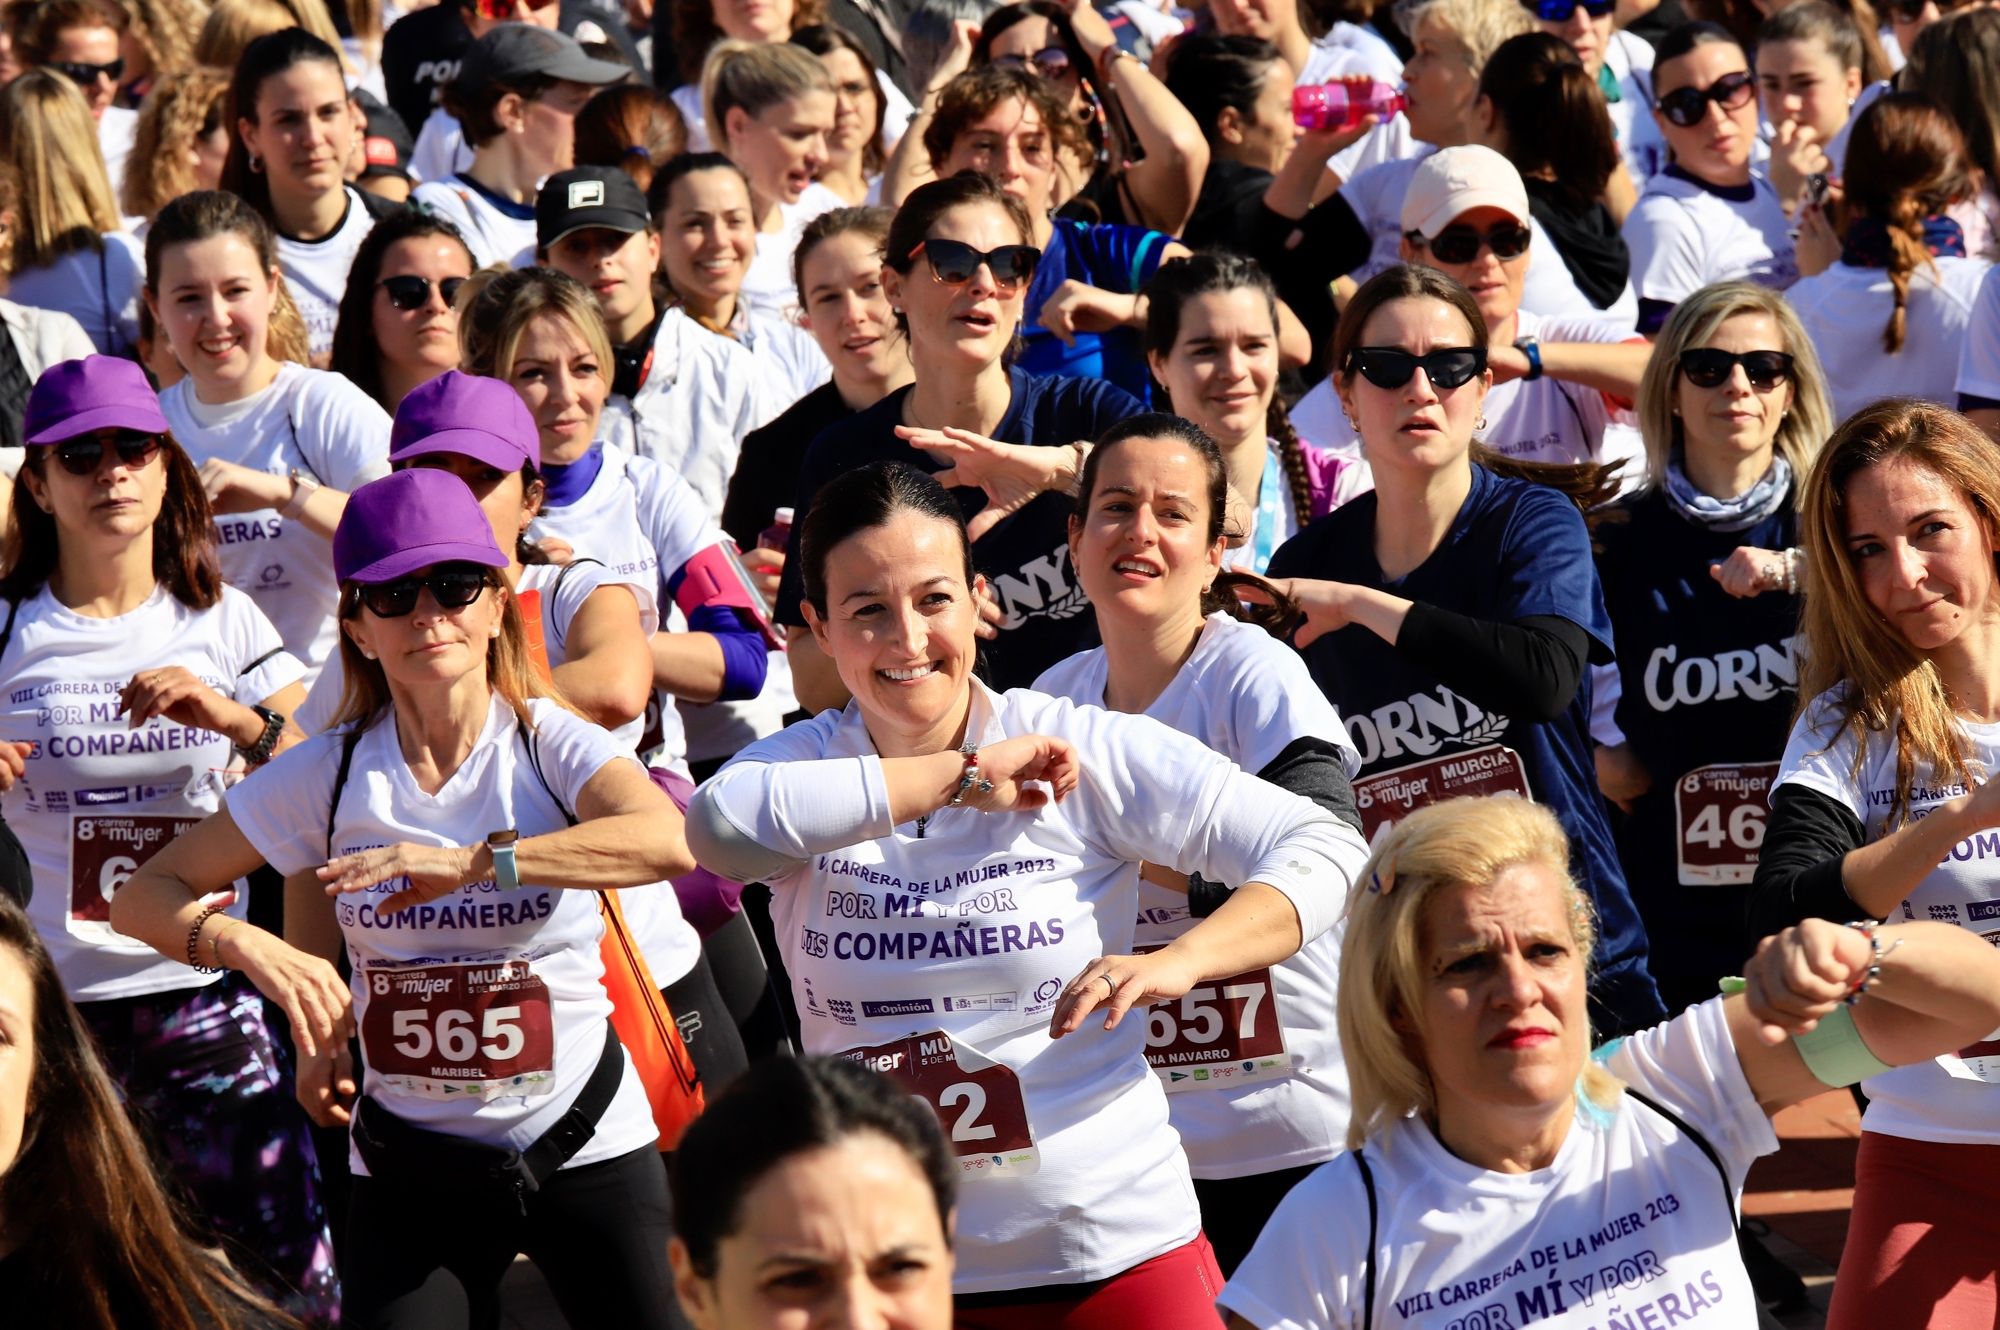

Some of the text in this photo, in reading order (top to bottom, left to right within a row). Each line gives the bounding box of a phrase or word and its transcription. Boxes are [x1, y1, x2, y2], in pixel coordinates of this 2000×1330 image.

[10, 689, 35, 704] VIII
[38, 682, 99, 698] CARRERA
[104, 682, 120, 694] DE
[37, 705, 84, 727] POR
[48, 723, 221, 758] COMPAÑERAS
[1440, 752, 1510, 780] MURCIA
[1463, 770, 1493, 784] MARZO
[1381, 778, 1428, 808] mujer
[1715, 777, 1768, 799] mujer
[98, 819, 134, 828] carrera
[109, 827, 163, 851] mujer
[831, 859, 902, 888] CARRERA
[907, 882, 930, 894] DE
[935, 876, 952, 893] LA
[956, 863, 1010, 888] MUJER
[1015, 858, 1056, 874] 2023
[358, 892, 551, 930] COMPAÑERAS
[826, 891, 877, 919] POR
[960, 888, 1018, 916] POR
[834, 918, 1064, 961] COMPAÑERAS
[402, 978, 453, 1002] mujer
[489, 982, 520, 992] MARZO
[392, 1006, 524, 1061] 565
[930, 1056, 943, 1064] DE
[1168, 1048, 1230, 1064] NAVARRO
[431, 1067, 486, 1078] MARIBEL
[1395, 1292, 1434, 1320] VIII
[1439, 1258, 1526, 1306] CARRERA
[1530, 1245, 1559, 1270] DE
[1563, 1237, 1587, 1260] LA
[1589, 1212, 1646, 1252] MUJER
[1515, 1268, 1568, 1326] MÍ
[1569, 1274, 1594, 1308] Y
[1599, 1250, 1667, 1300] POR
